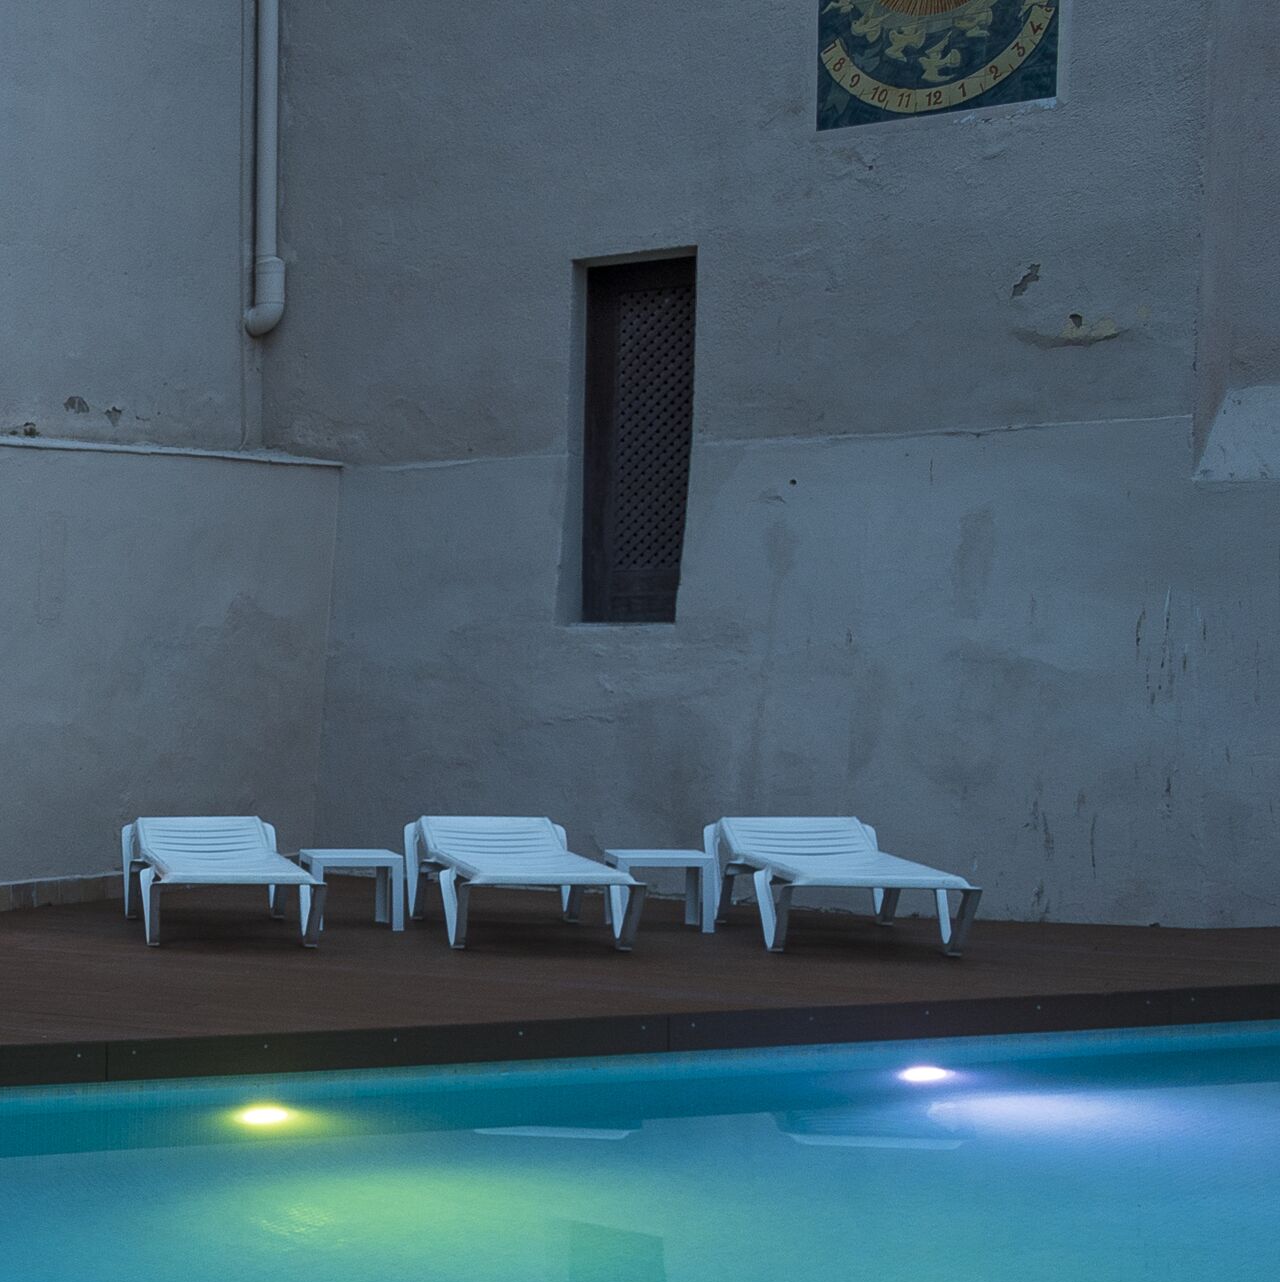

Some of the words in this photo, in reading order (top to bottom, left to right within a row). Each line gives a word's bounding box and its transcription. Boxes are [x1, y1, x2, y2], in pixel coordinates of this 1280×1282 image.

[832, 57, 845, 72] 8
[849, 74, 860, 88] 9
[871, 86, 888, 103] 10
[898, 92, 911, 108] 11
[925, 91, 943, 106] 12
[959, 82, 967, 97] 1
[989, 65, 1002, 80] 2
[1011, 41, 1025, 57] 3
[1030, 20, 1043, 35] 4
